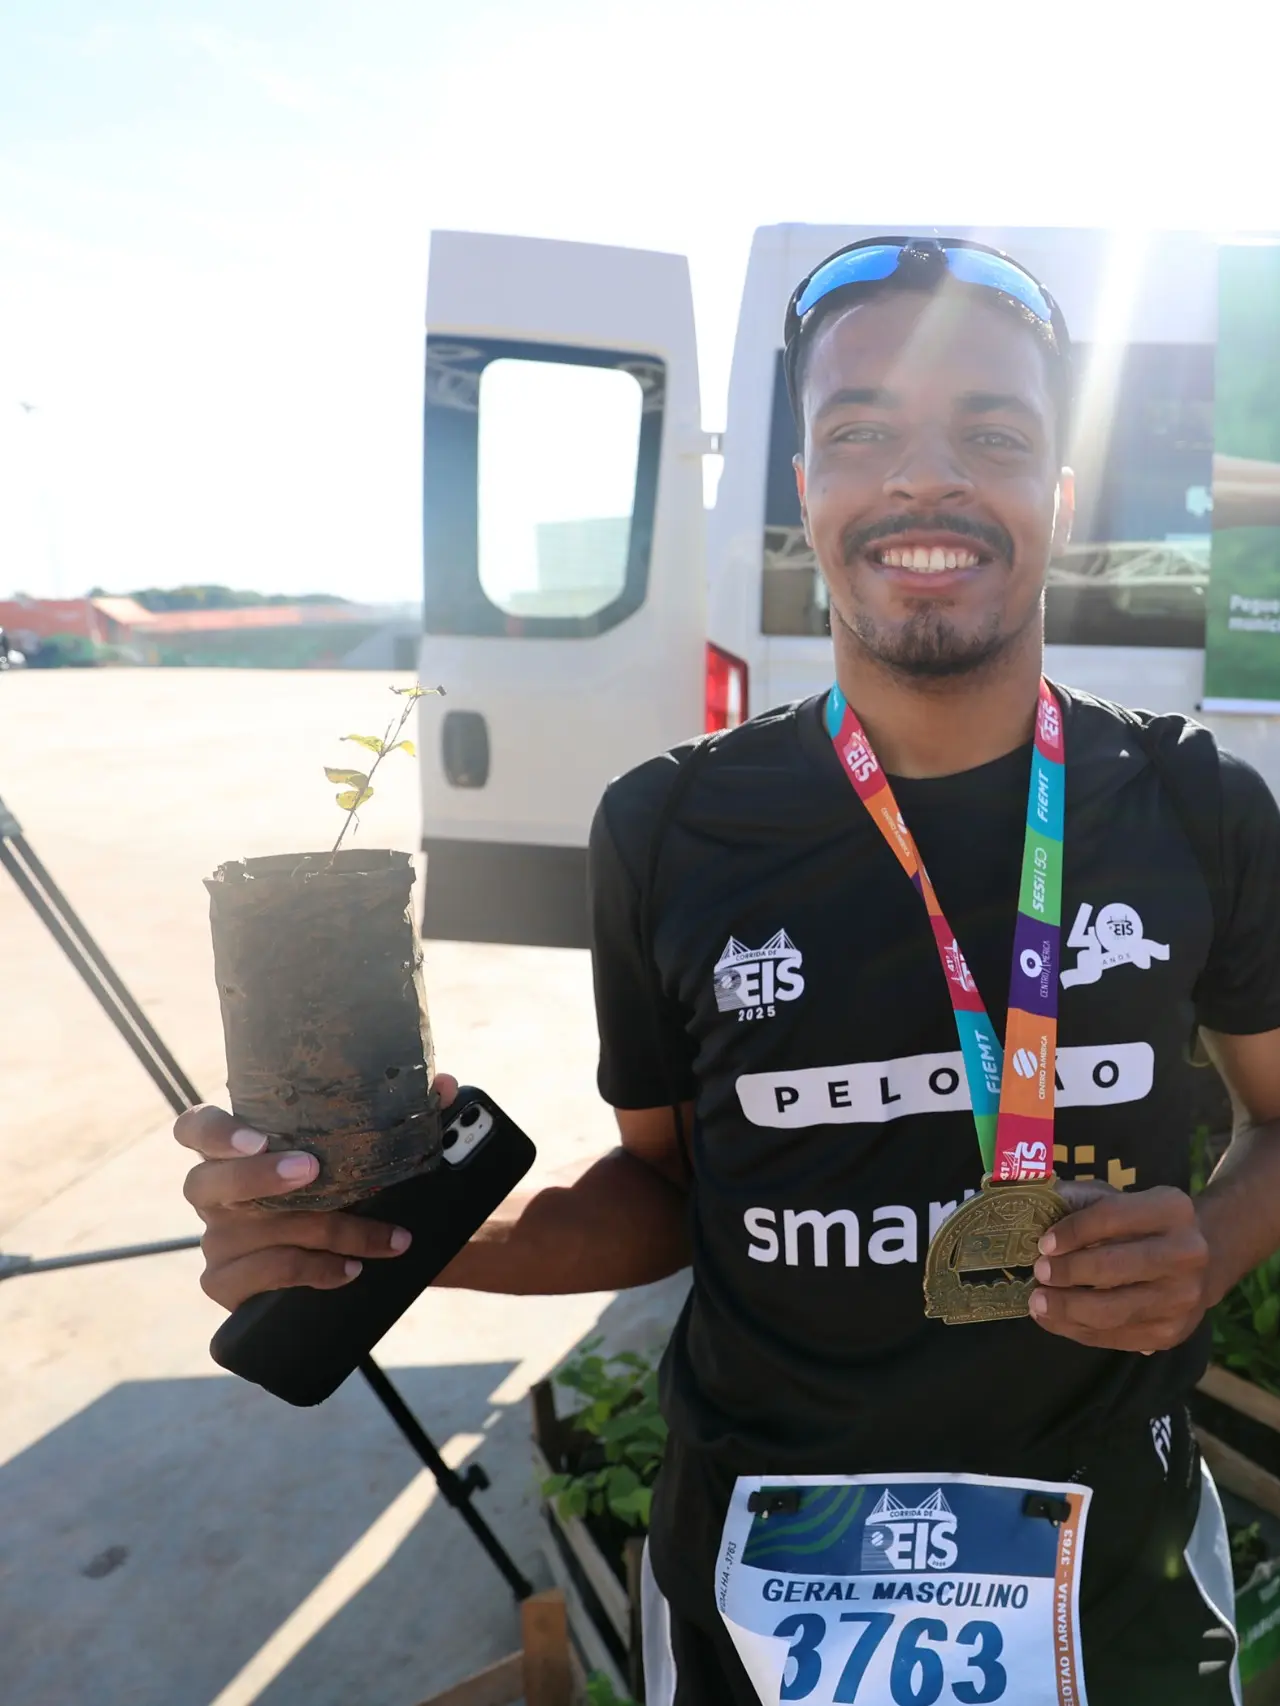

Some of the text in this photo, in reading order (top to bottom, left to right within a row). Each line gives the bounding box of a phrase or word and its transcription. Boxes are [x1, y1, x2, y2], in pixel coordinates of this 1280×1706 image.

[1229, 595, 1280, 616] Pegue
[735, 950, 767, 961] CORRIDA
[738, 1005, 776, 1022] 2025
[774, 1059, 1120, 1114] PELOO
[1038, 1069, 1047, 1100] CENTRO
[743, 1188, 976, 1268] smar
[889, 1510, 922, 1518] CORRIDA
[725, 1541, 737, 1566] 3763
[1060, 1529, 1073, 1565] 3763
[762, 1578, 1029, 1610] GERAL MASCULINO
[1057, 1583, 1069, 1652] LARANJA
[773, 1611, 1008, 1704] 3763
